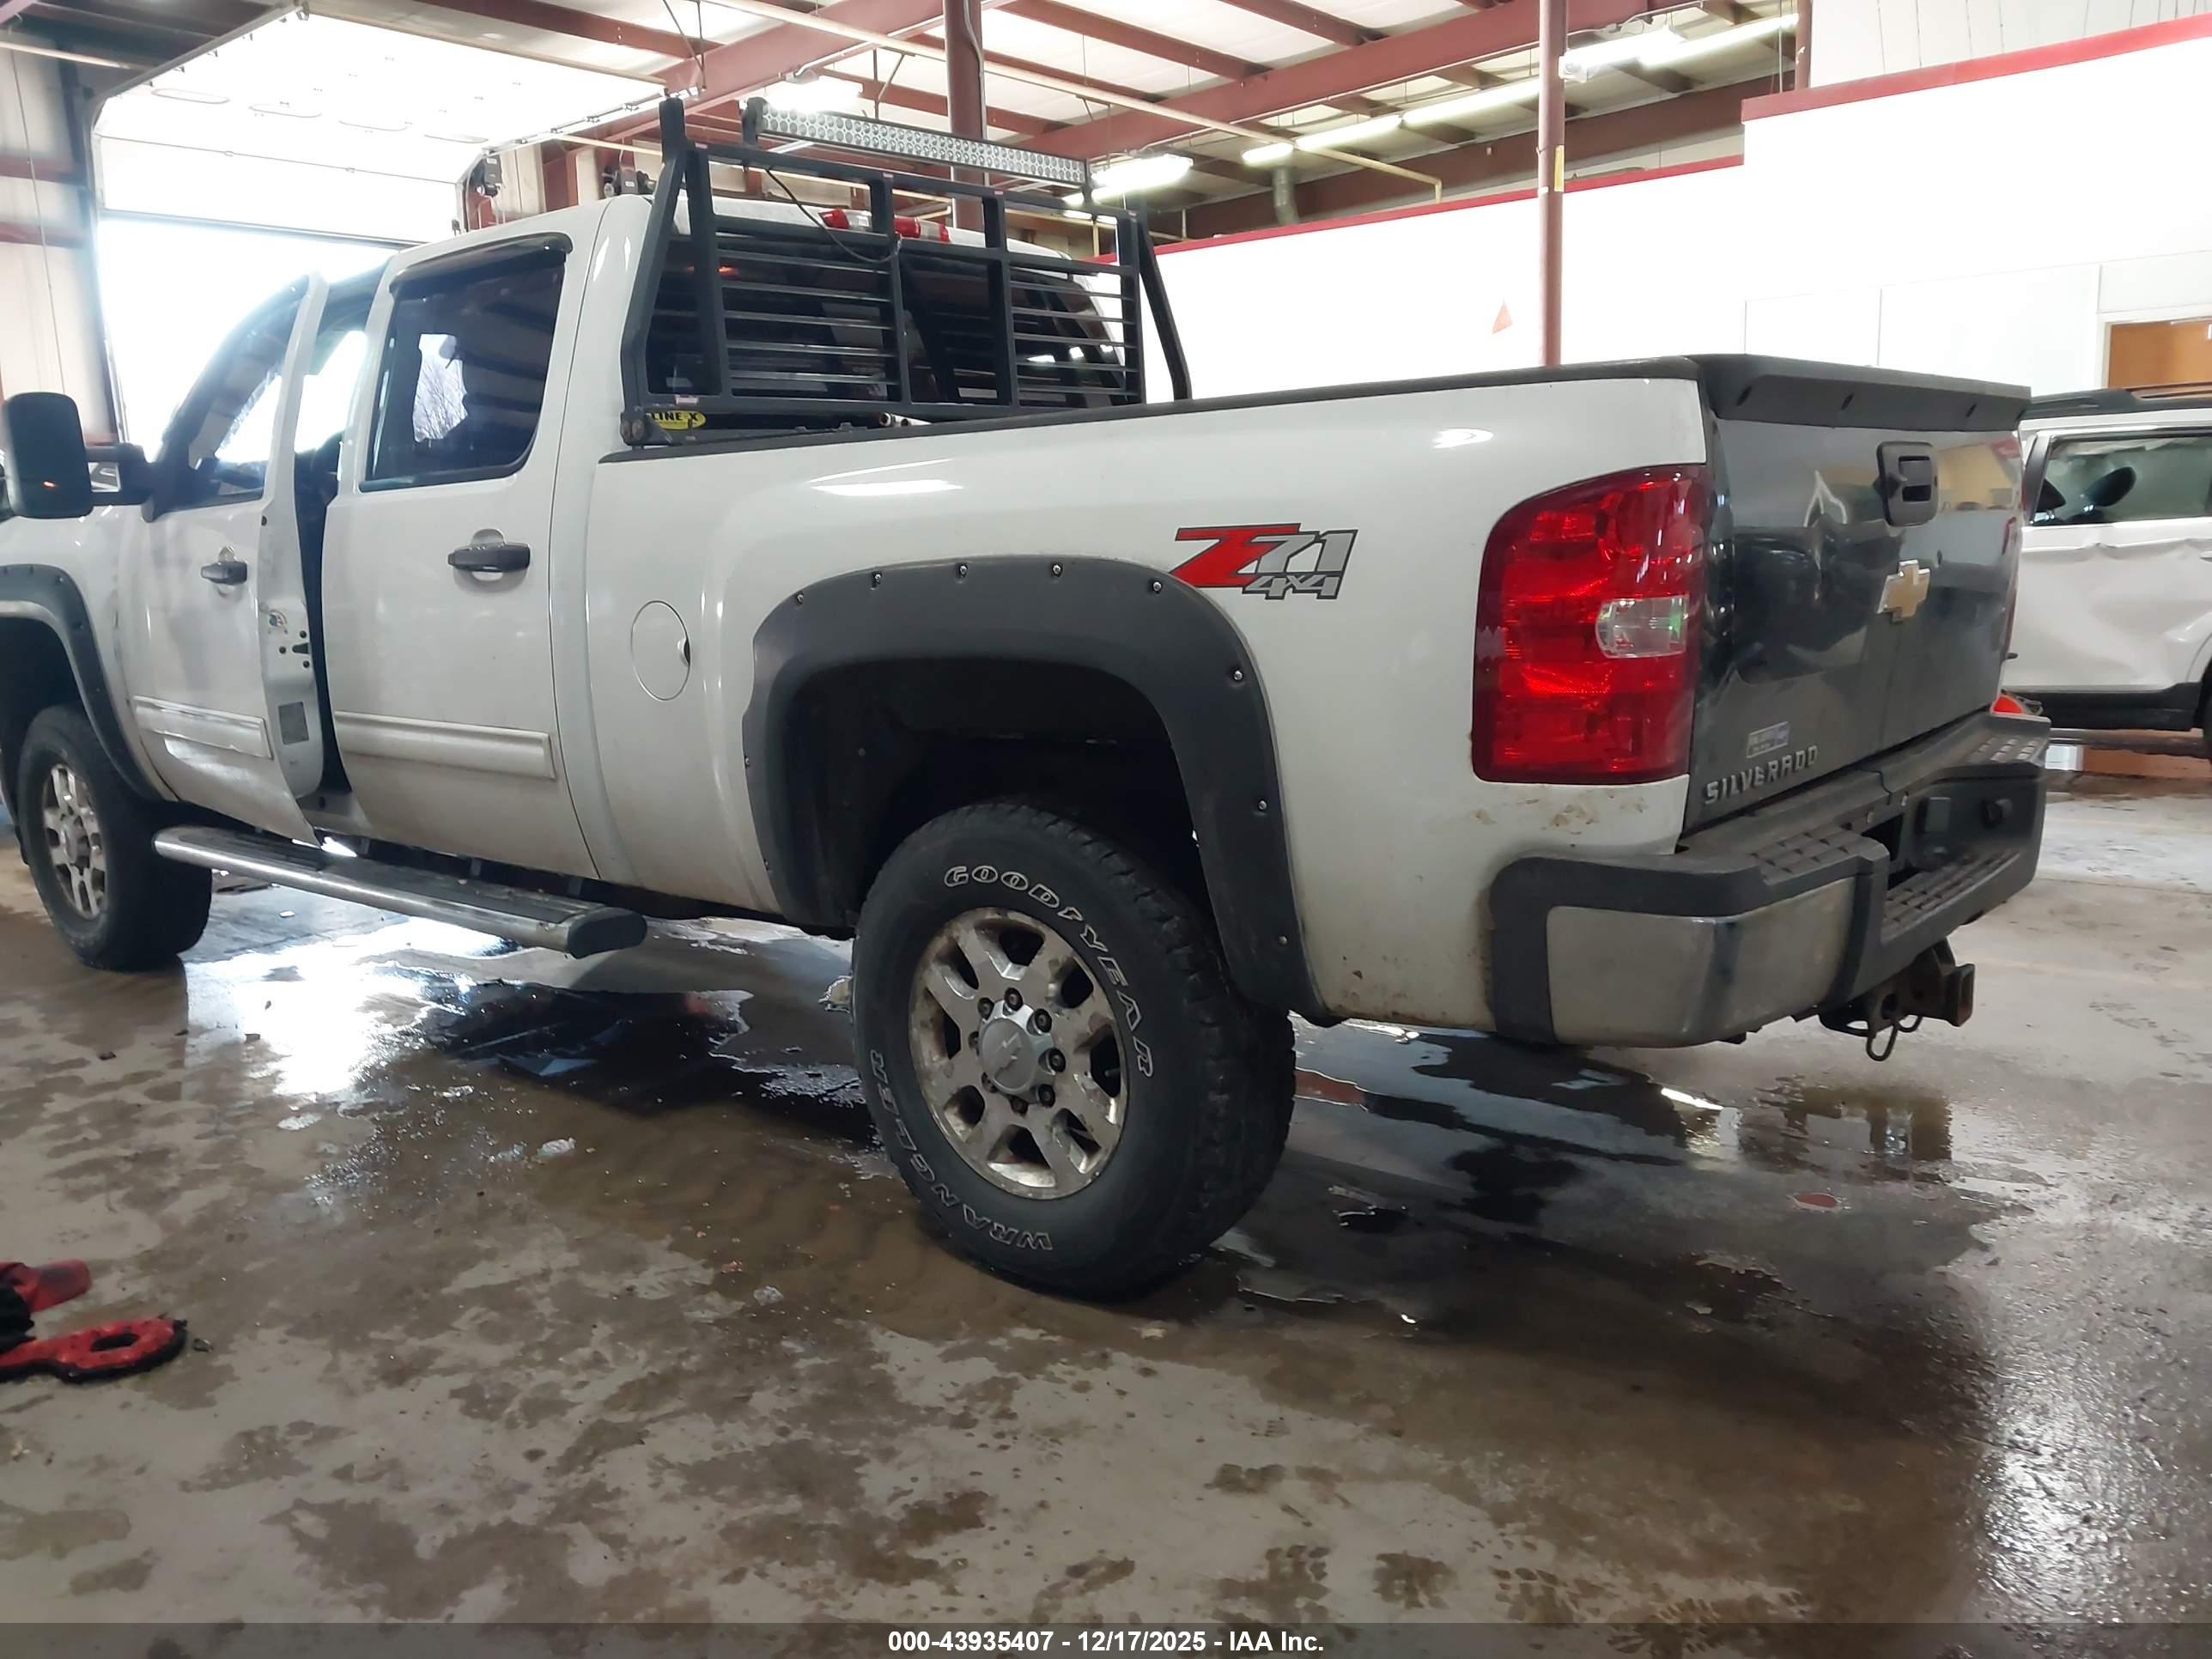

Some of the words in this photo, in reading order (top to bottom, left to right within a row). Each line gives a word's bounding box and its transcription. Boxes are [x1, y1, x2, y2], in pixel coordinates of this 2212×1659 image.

[651, 411, 684, 421] LINE
[1169, 522, 1358, 588] Z71
[1704, 744, 1819, 805] SILVERADO
[944, 864, 1154, 1079] GOODYEAR
[870, 1048, 1054, 1251] WRANGLER
